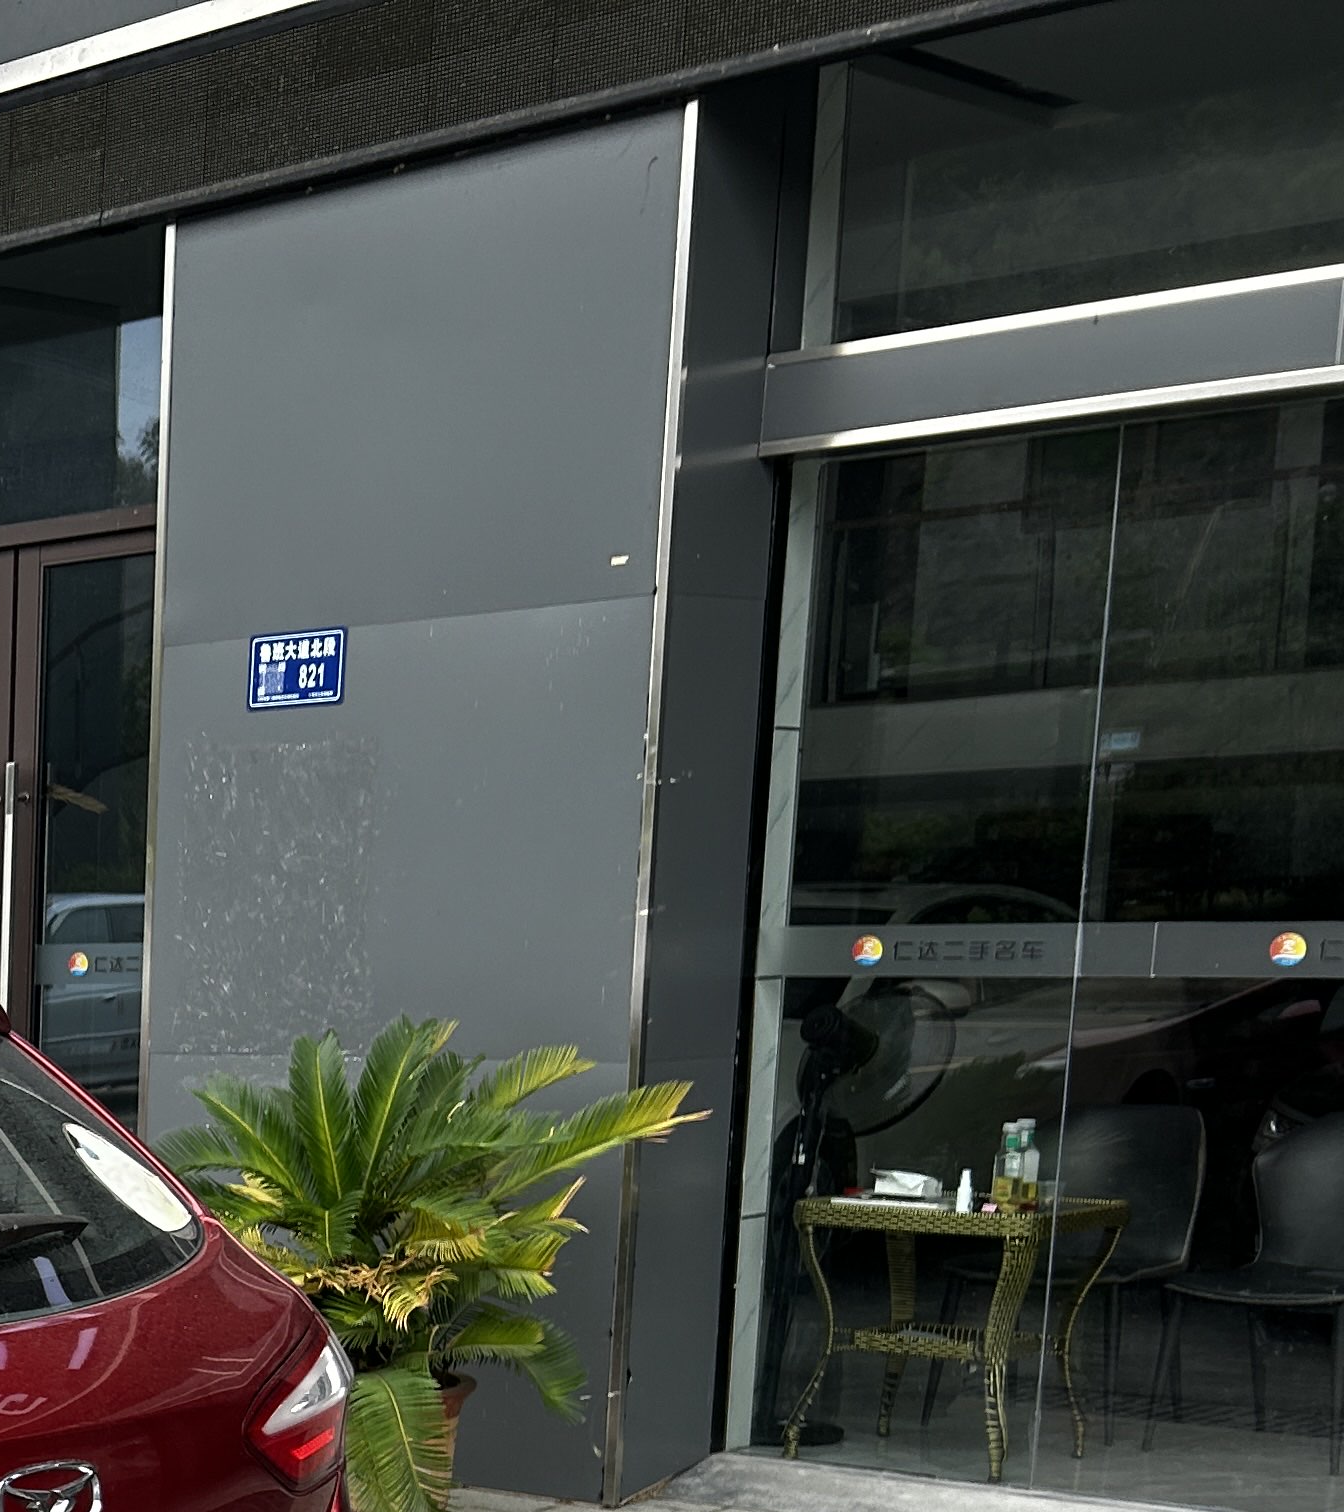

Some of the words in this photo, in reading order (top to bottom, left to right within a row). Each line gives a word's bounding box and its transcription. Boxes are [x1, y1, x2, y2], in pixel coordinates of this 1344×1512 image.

[298, 663, 325, 689] 821
[893, 939, 1046, 960] 仁达二手名车
[94, 956, 139, 973] 仁达二
